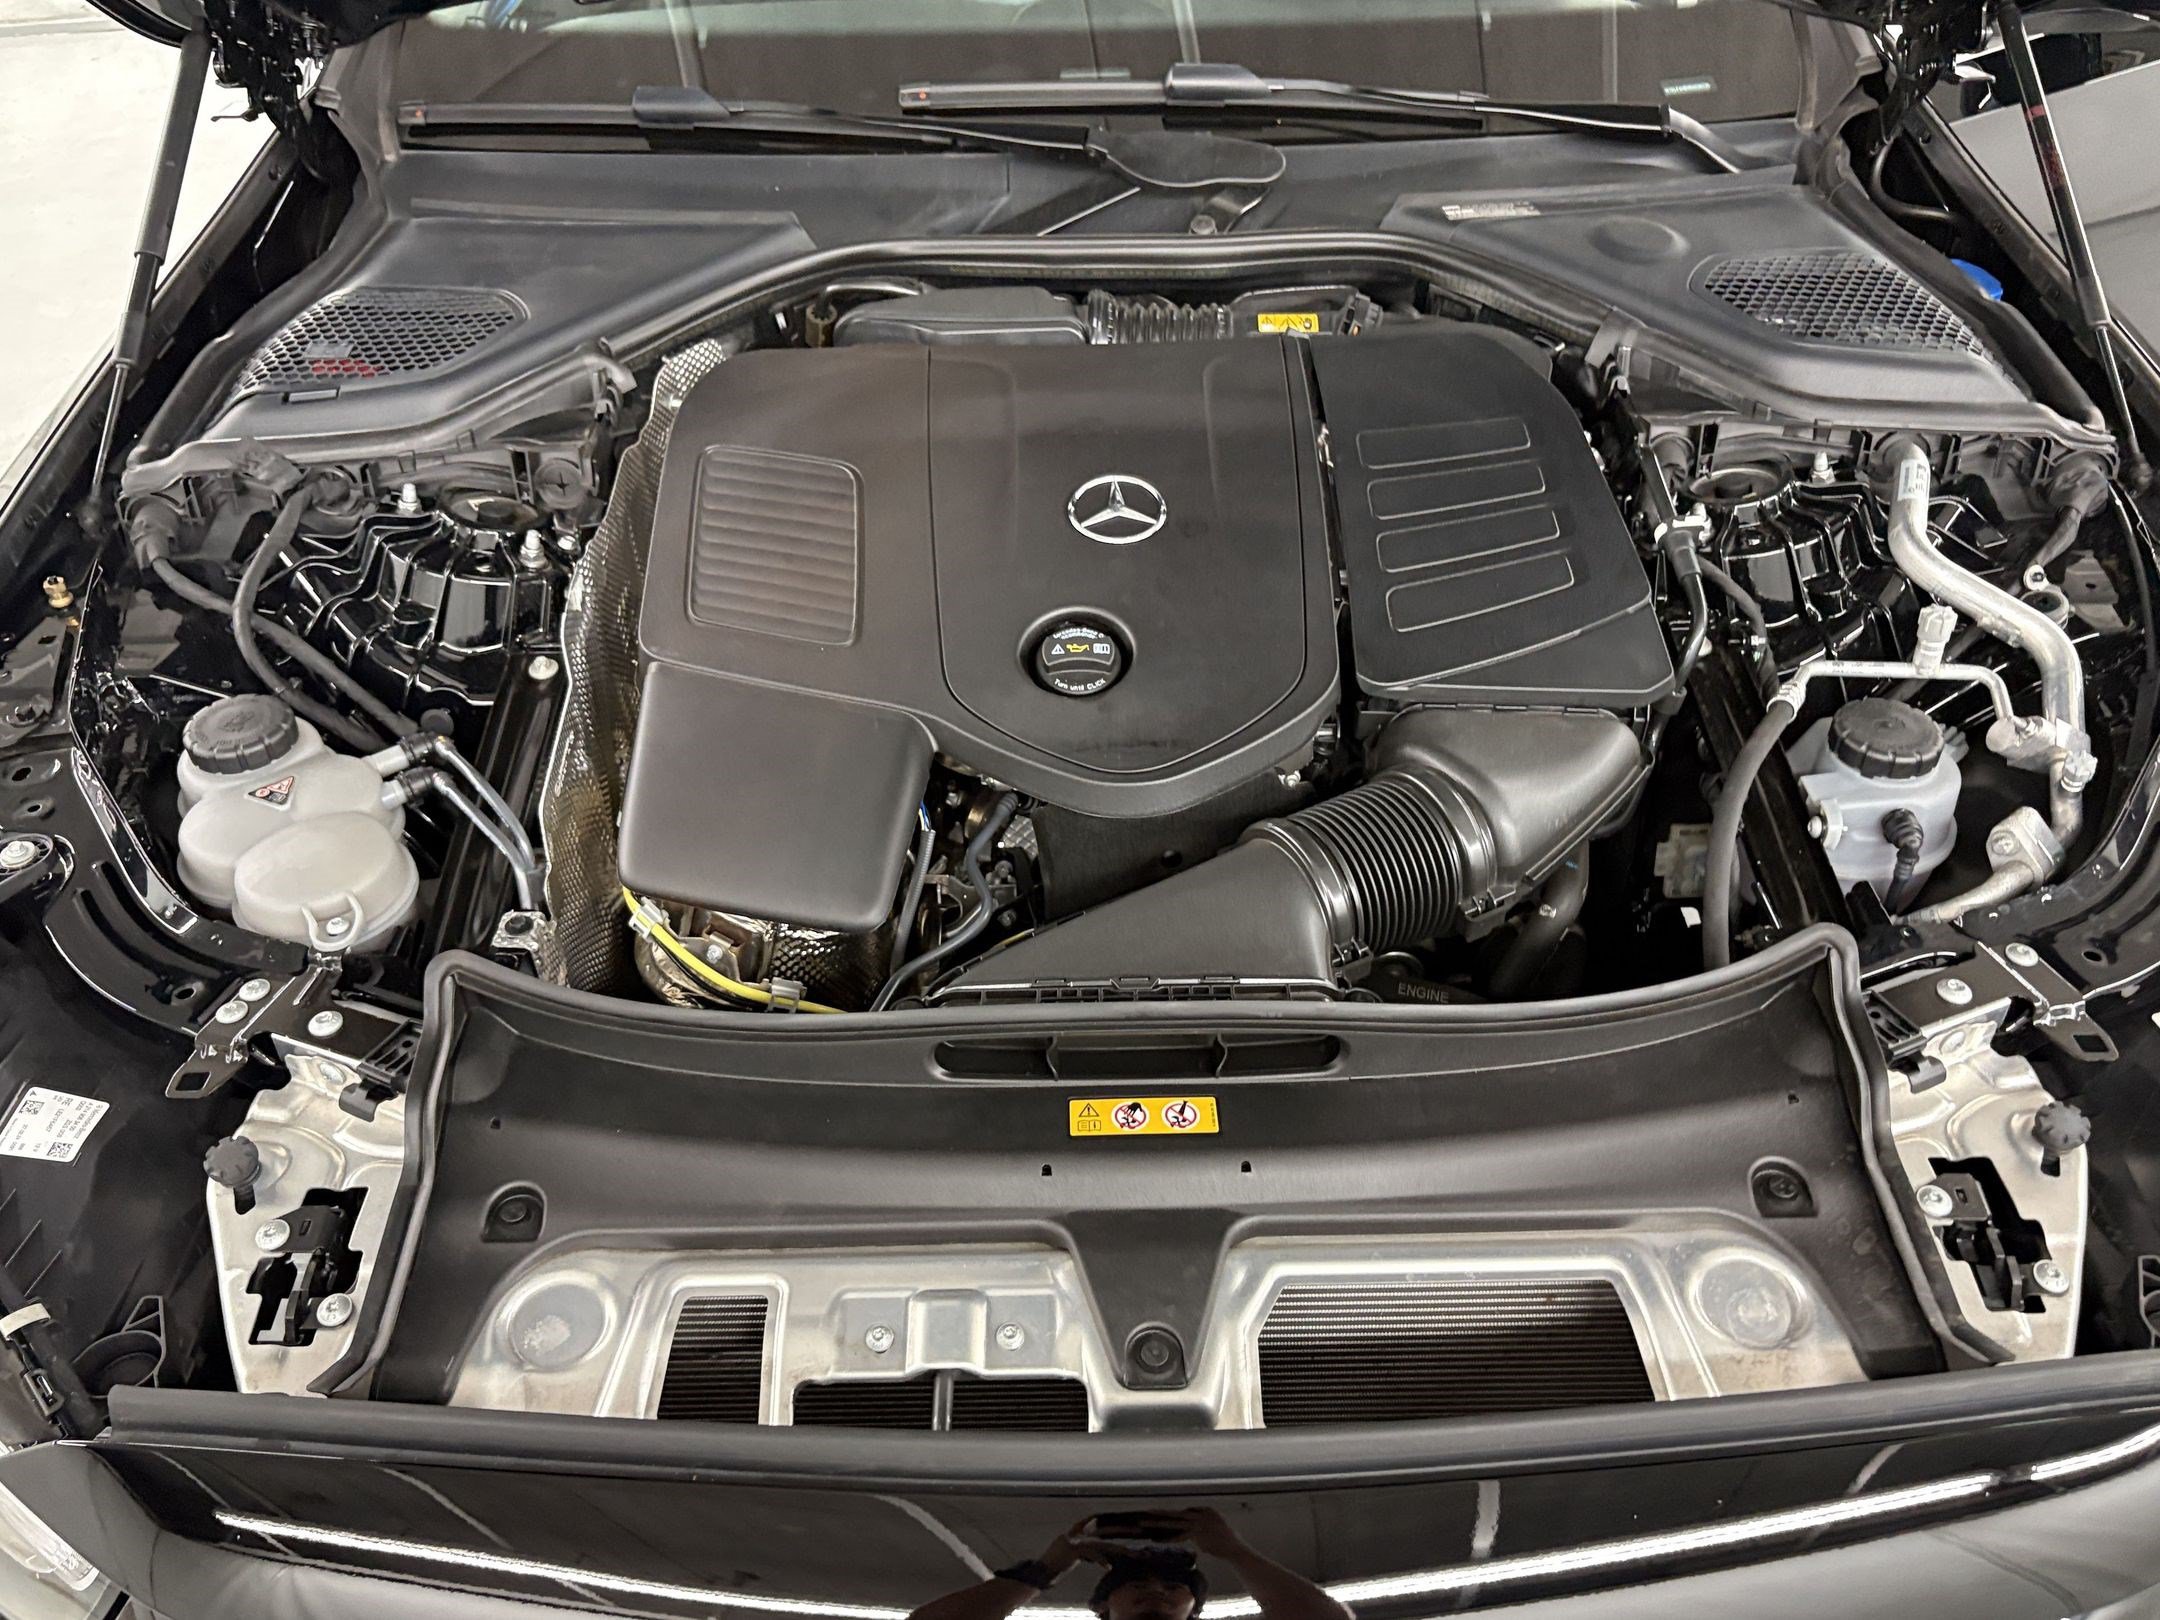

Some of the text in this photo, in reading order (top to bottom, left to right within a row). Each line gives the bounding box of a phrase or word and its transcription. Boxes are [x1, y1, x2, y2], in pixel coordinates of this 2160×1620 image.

[1054, 677, 1106, 691] Turn until CLICK
[1398, 982, 1449, 1003] ENGINE
